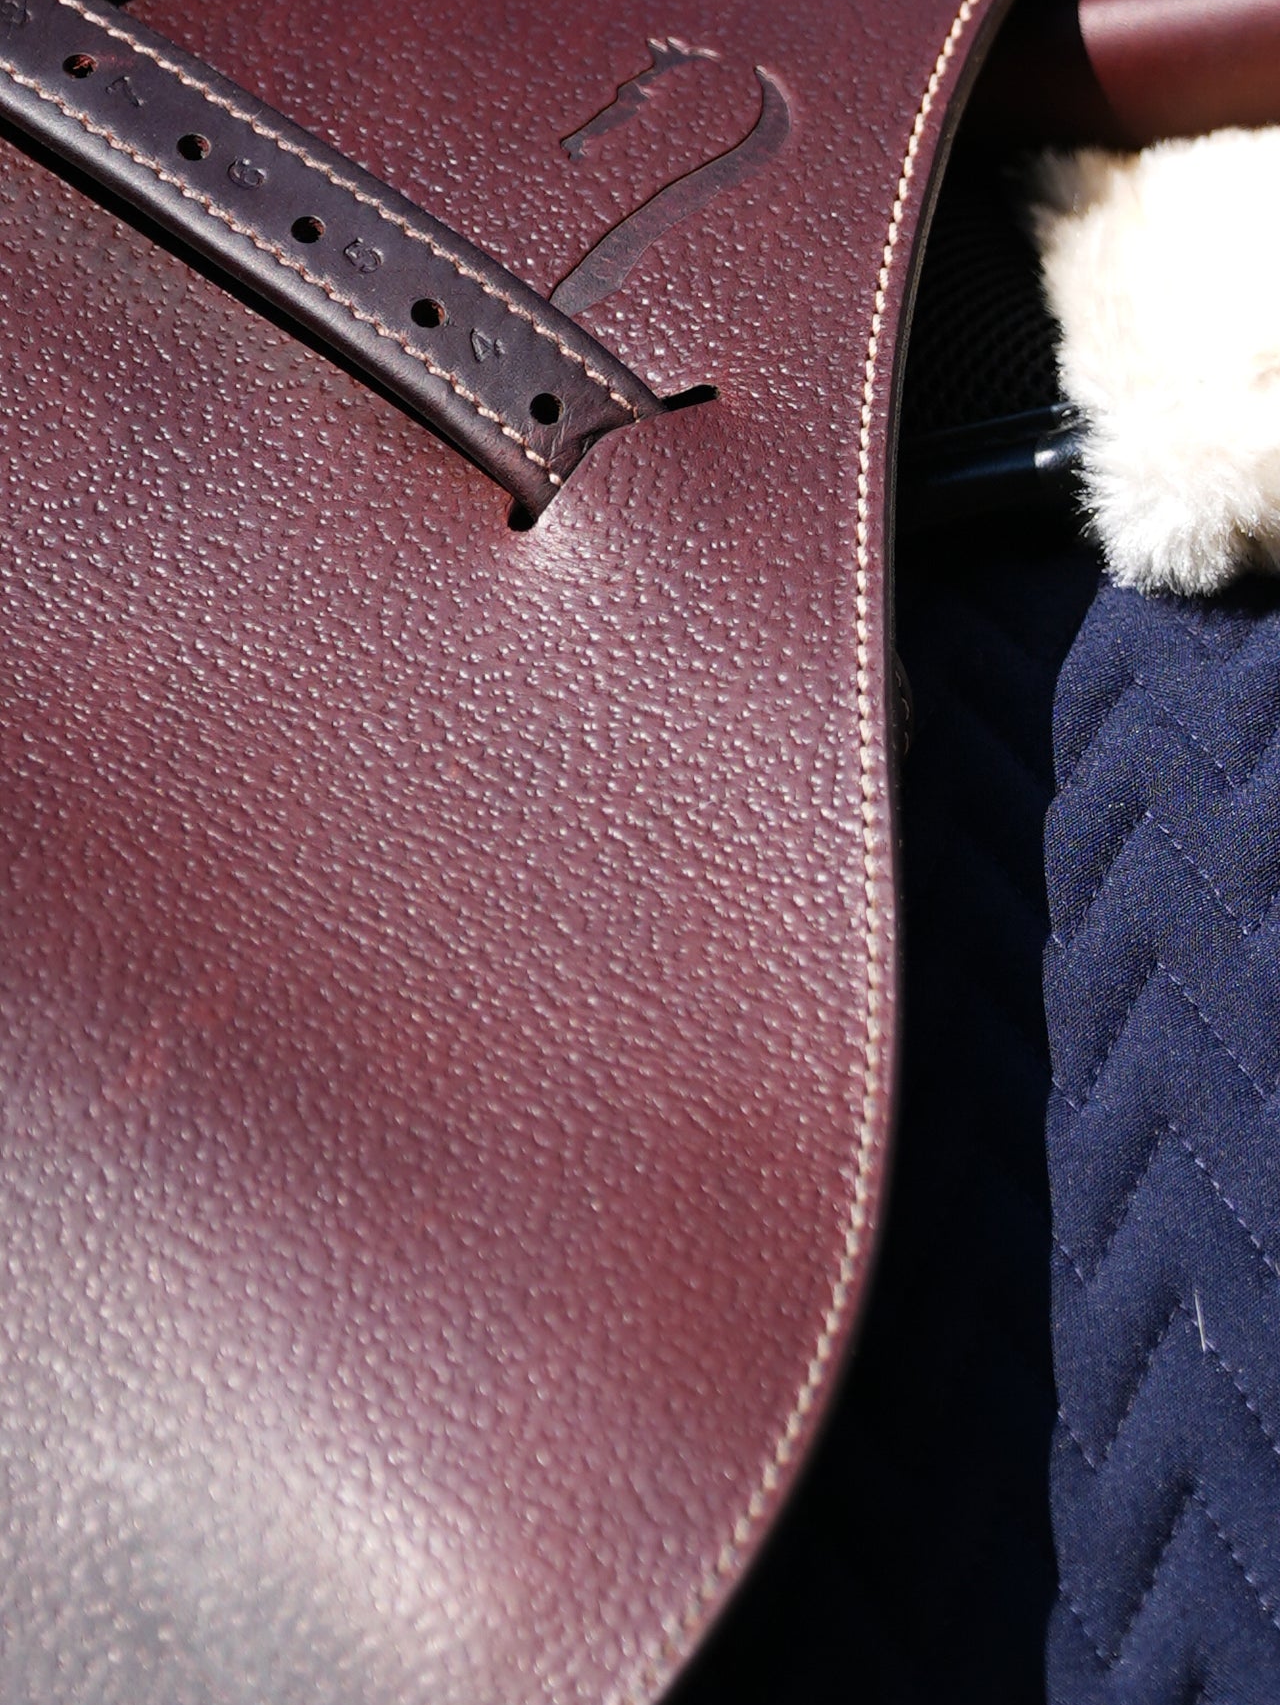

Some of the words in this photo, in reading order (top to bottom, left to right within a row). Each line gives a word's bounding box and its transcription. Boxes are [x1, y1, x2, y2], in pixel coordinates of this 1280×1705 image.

[105, 76, 144, 107] 7
[228, 157, 267, 190] 6
[343, 237, 384, 273] 5
[470, 327, 506, 363] 4
